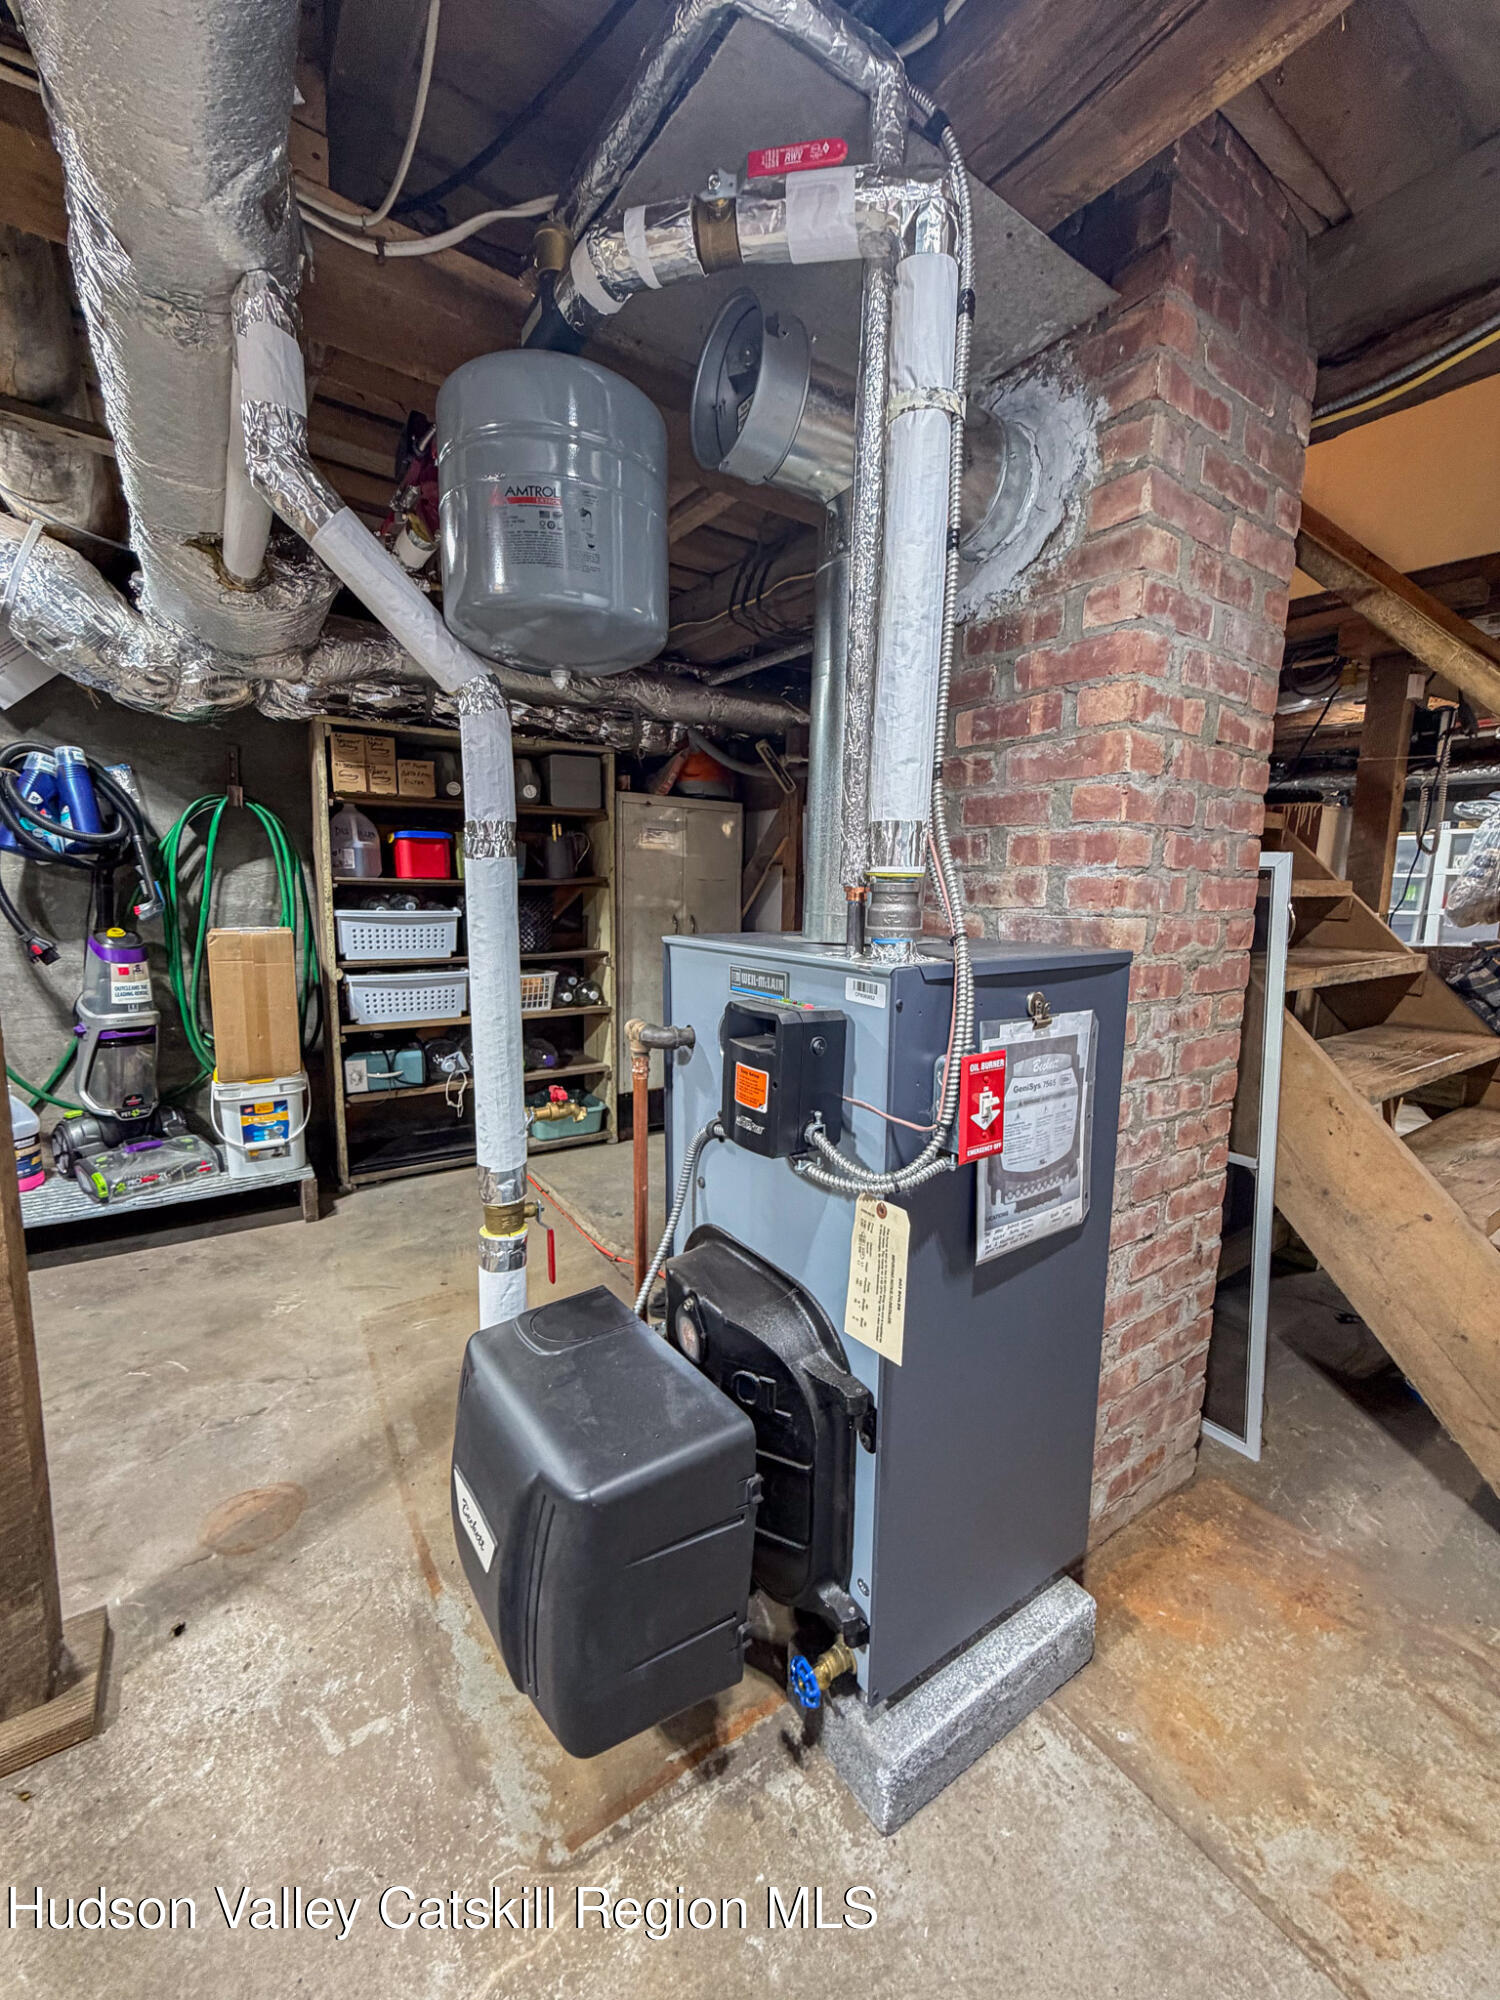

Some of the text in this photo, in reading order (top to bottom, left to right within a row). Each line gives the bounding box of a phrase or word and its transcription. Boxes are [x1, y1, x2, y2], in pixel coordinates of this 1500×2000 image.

[504, 485, 559, 497] AMTROL
[969, 1058, 1005, 1073] OIL BURNER
